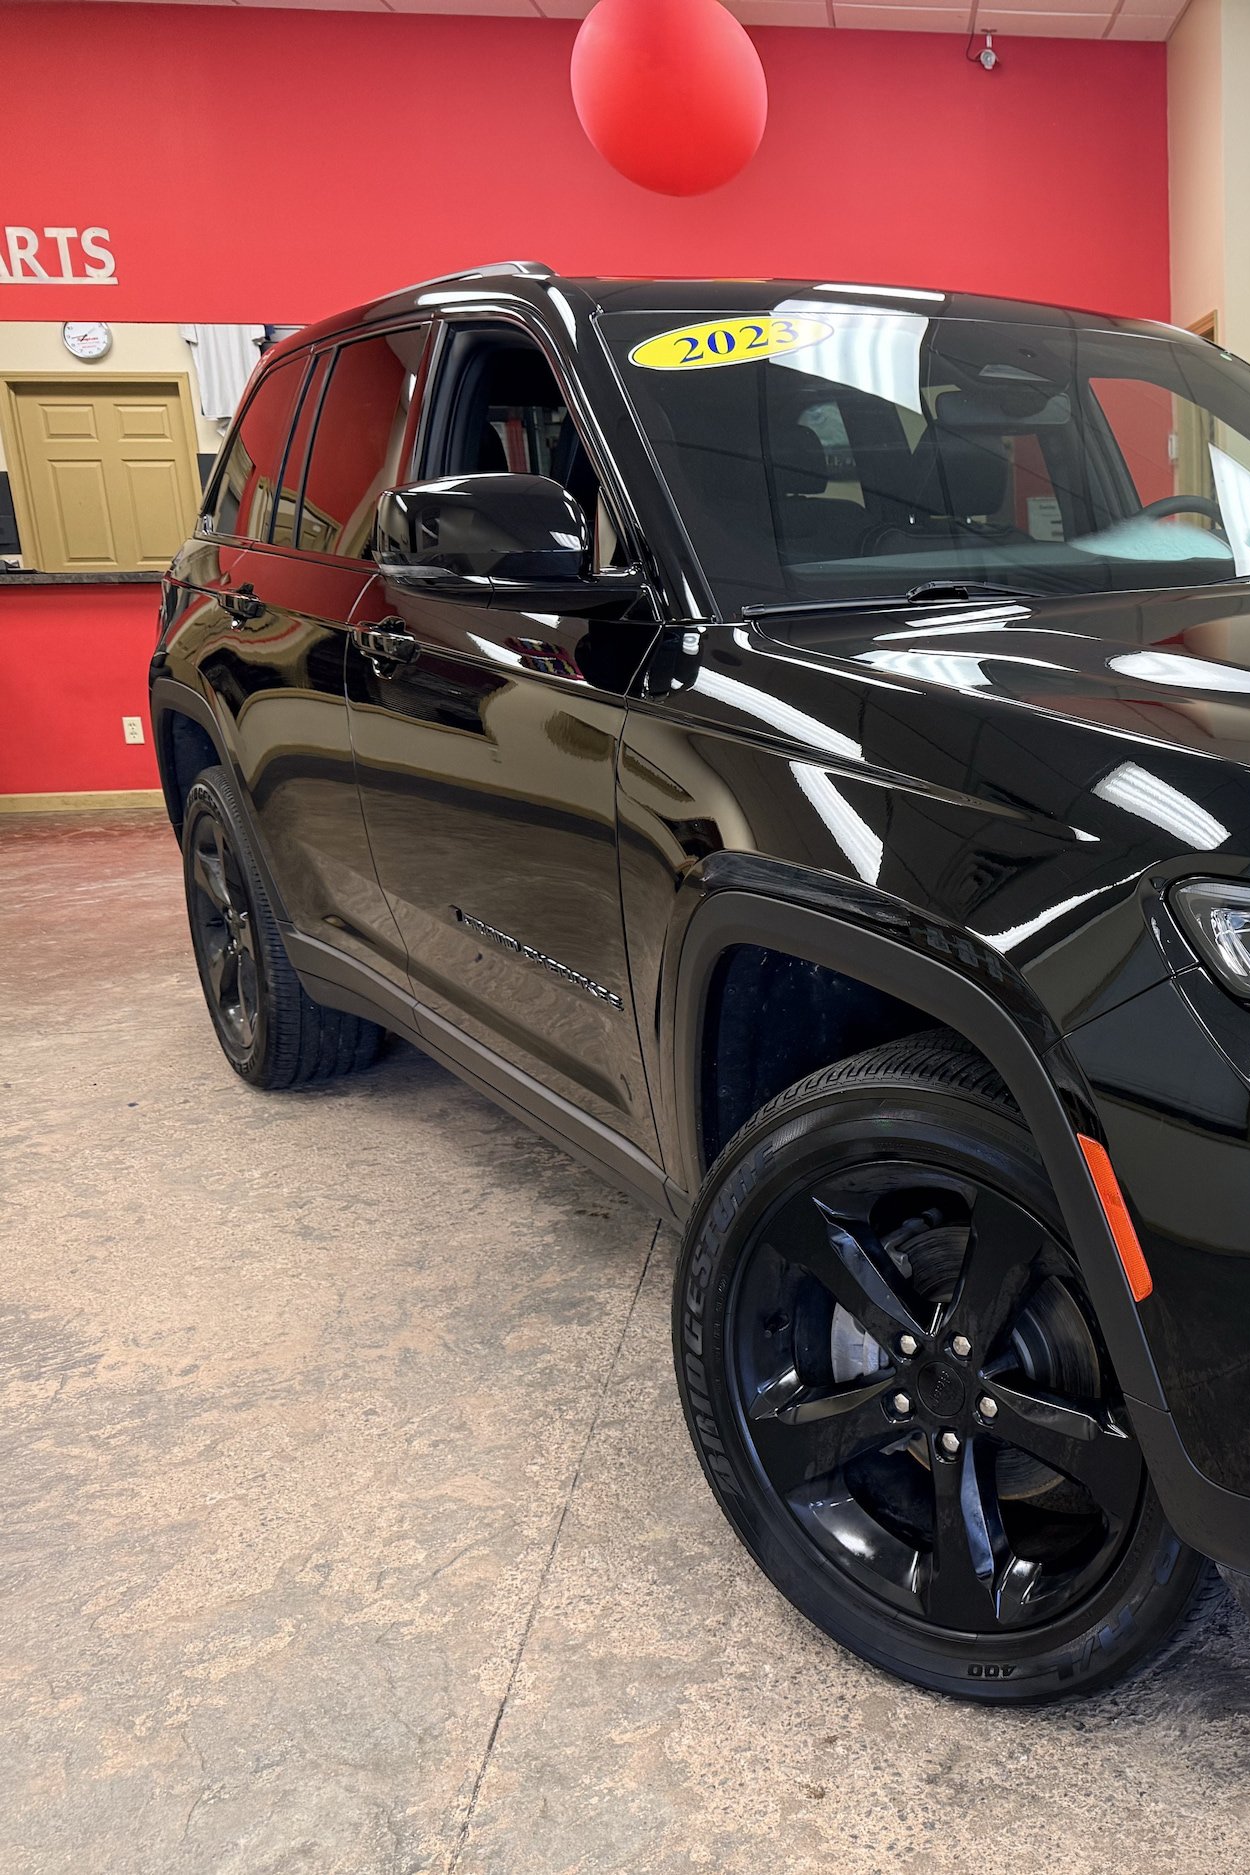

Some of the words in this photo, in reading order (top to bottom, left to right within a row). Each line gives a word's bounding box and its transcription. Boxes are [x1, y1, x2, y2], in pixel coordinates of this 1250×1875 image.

[0, 226, 116, 279] RTS
[673, 320, 800, 364] 2023
[966, 1663, 1017, 1678] 400
